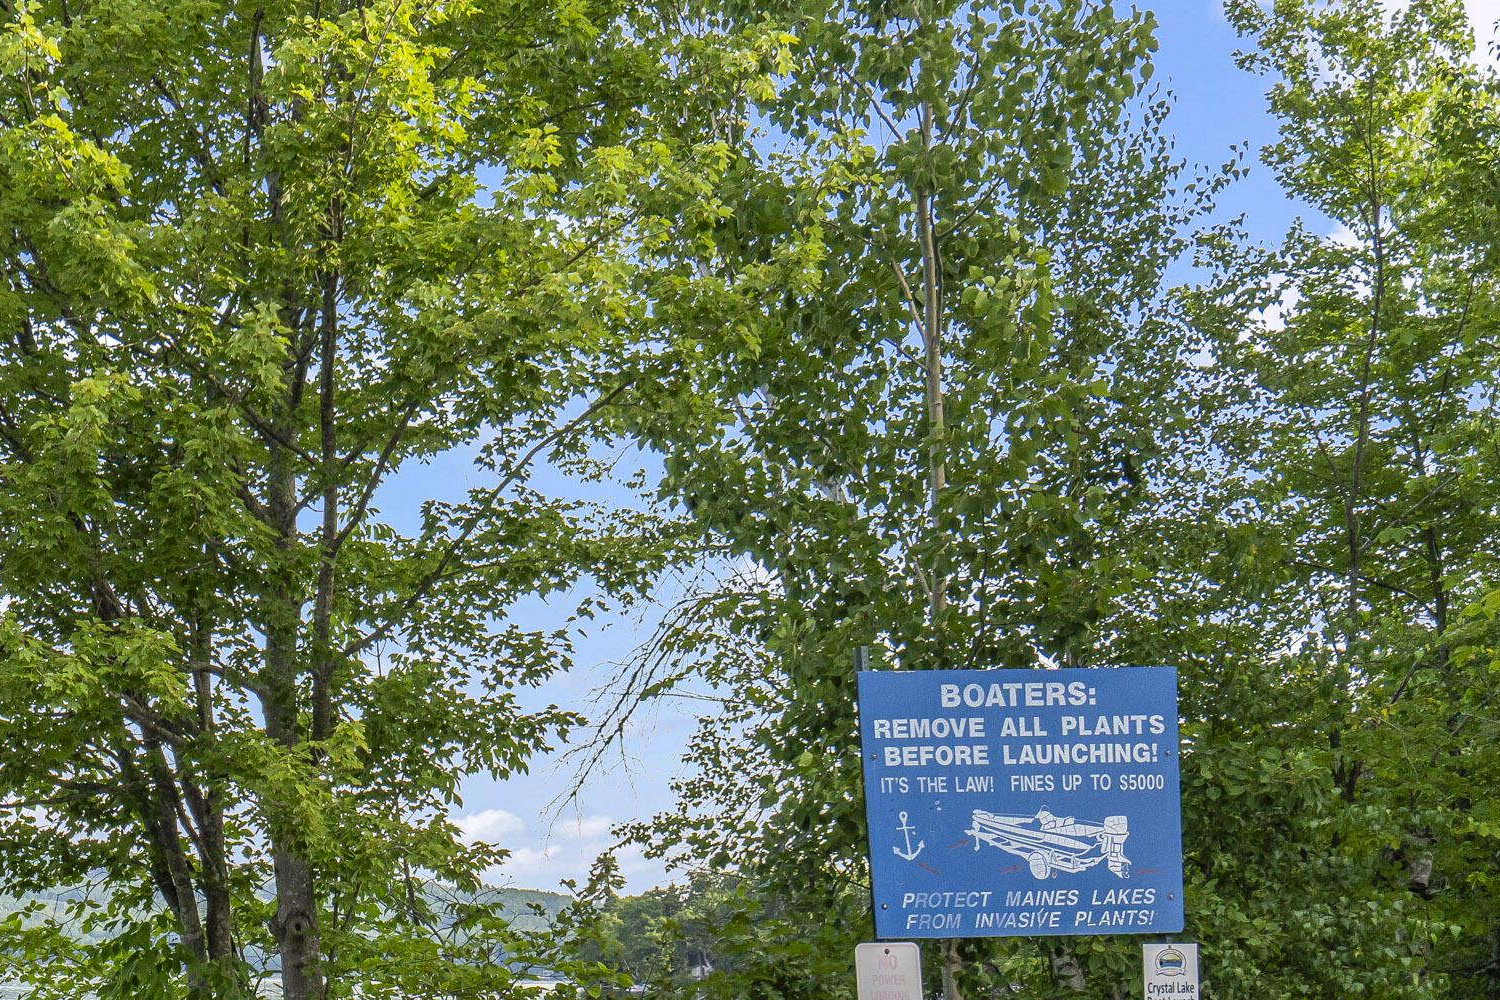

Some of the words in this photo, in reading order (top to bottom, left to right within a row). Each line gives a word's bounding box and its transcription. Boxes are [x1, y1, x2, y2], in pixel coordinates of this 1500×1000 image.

[940, 681, 1097, 708] BOATERS:
[873, 717, 986, 739] REMOVE
[1000, 716, 1048, 737] ALL
[1061, 714, 1166, 736] PLANTS
[884, 745, 989, 767] BEFORE
[1003, 743, 1158, 765] LAUNCHING!
[880, 777, 909, 794] IT'S
[917, 776, 948, 793] THE
[955, 775, 995, 793] LAW!
[1011, 774, 1055, 792] FINES
[1062, 774, 1082, 791] UP
[1090, 773, 1112, 791] TO
[902, 891, 992, 909] PROTECT
[1005, 889, 1079, 907] MAINES
[1091, 888, 1157, 906] LAKES
[906, 913, 961, 930] FROM
[975, 910, 1061, 929] INVASIVE
[1074, 910, 1155, 927] PLANTS!
[878, 954, 898, 970] NO
[1147, 981, 1175, 996] Crystal
[1177, 981, 1195, 993] Lake
